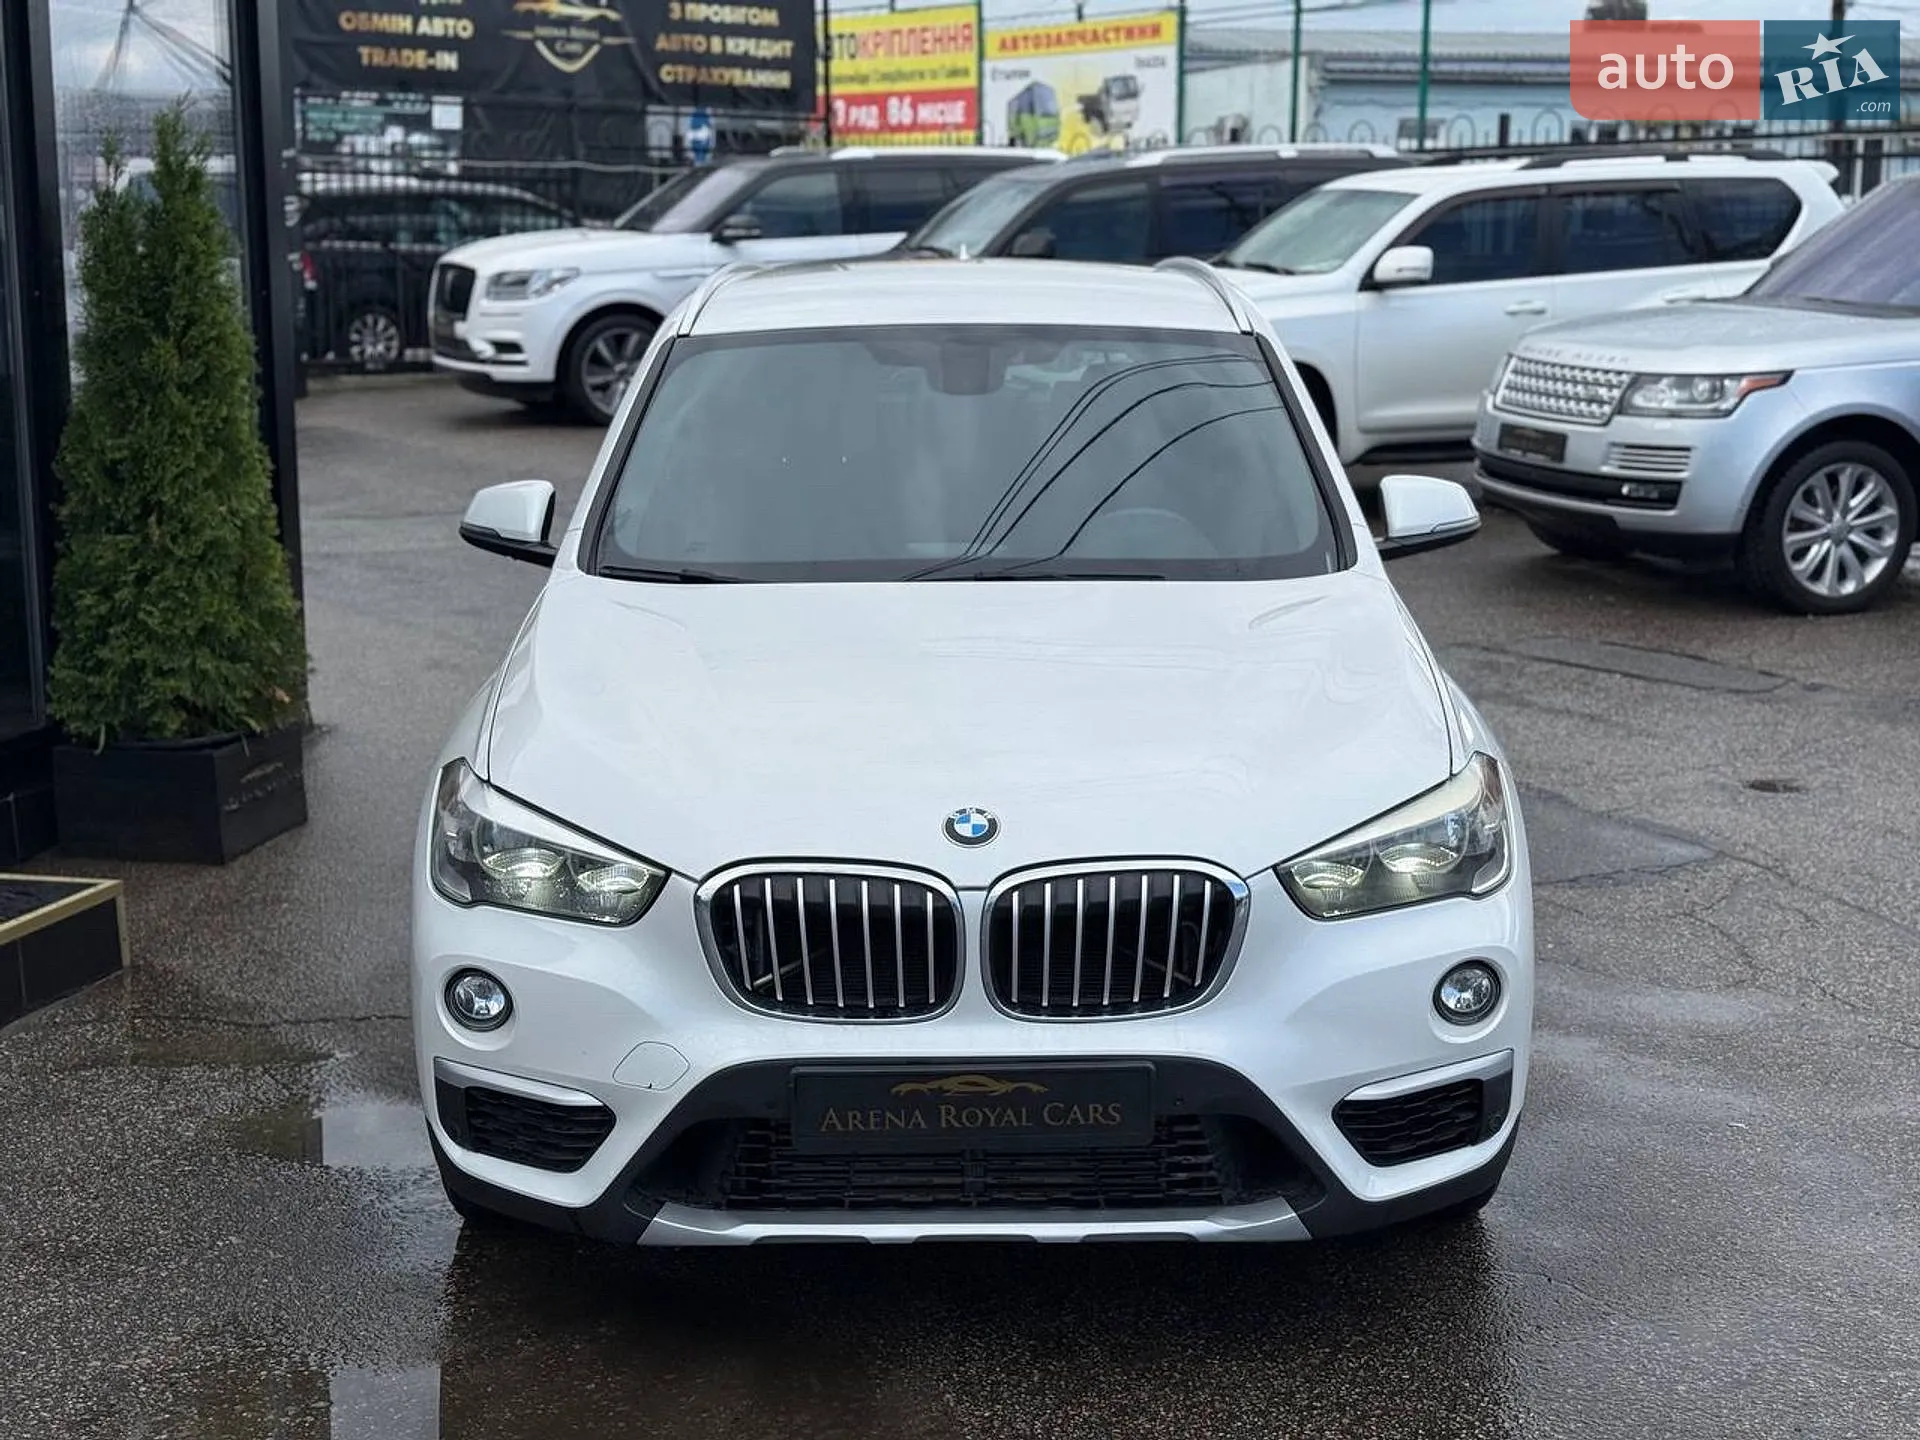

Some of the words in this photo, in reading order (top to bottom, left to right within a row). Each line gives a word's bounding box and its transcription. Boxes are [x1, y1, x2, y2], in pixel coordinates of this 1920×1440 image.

[338, 10, 413, 35] ОБМІН
[416, 15, 475, 40] АВТО
[684, 2, 780, 27] ПРОБІГОМ
[655, 32, 707, 55] АВТО
[709, 34, 723, 55] В
[725, 36, 794, 61] КРЕДИТ
[998, 22, 1162, 53] АВТОЗАПЧАСТИНИ
[356, 45, 460, 72] TRADE-IN
[659, 63, 792, 90] СТРАХУВАННЯ
[820, 1106, 928, 1132] ARENA
[940, 1104, 1034, 1129] ROYAL
[1043, 1102, 1122, 1127] CARS
